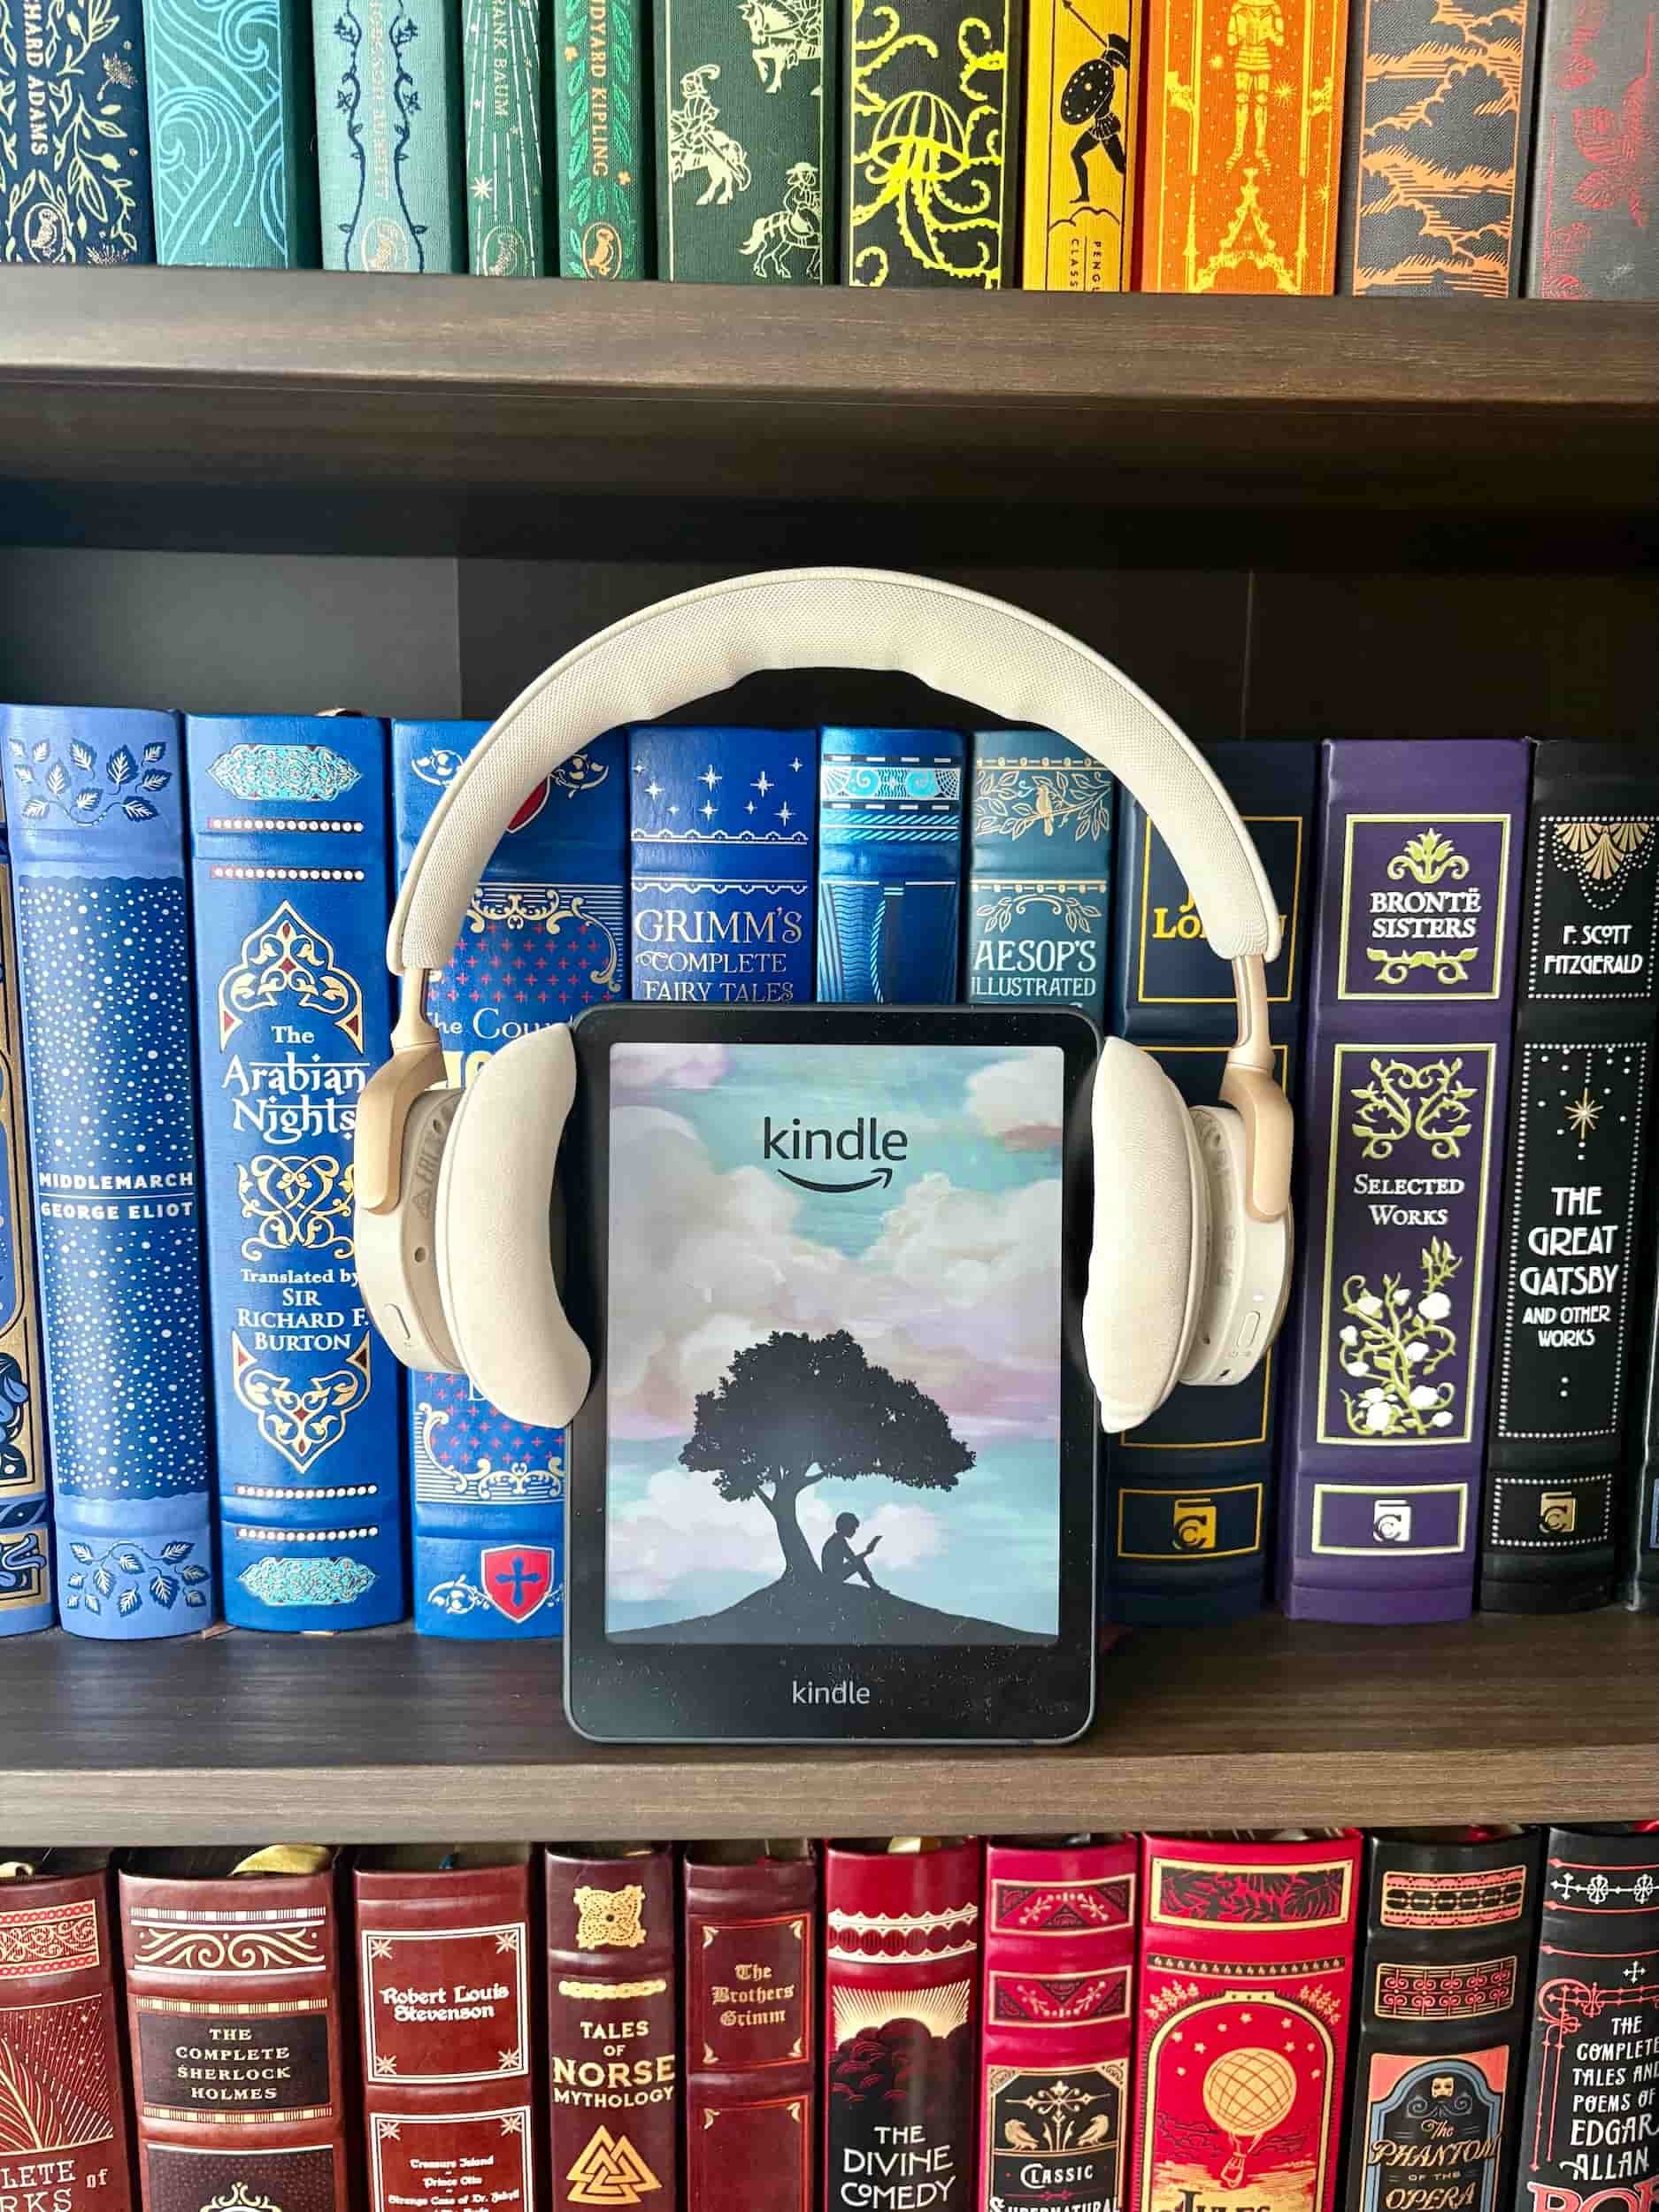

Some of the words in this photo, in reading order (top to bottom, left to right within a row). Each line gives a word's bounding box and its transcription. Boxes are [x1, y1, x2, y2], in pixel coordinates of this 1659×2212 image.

[588, 0, 608, 78] DYARD
[494, 58, 511, 116] BAUM
[27, 75, 49, 156] ADAMS
[591, 88, 610, 178] KIPLING
[1369, 887, 1482, 913] BRONTË
[634, 906, 803, 944] GRIMM'S
[1371, 917, 1478, 939] SISTERS
[1563, 925, 1578, 945] F.
[1580, 925, 1633, 945] SCOTT
[635, 949, 787, 973] COMPLETE
[973, 939, 1096, 972] AESOP'S
[1543, 953, 1644, 975] FITZGERALD
[643, 979, 712, 1002] FAIRY
[719, 980, 795, 1002] TALES
[971, 976, 1096, 996] ILLUSTRATED
[271, 1025, 316, 1045] The
[221, 1051, 368, 1096] Arabian
[232, 1094, 356, 1144] Nights
[764, 1116, 908, 1162] kindle
[38, 1171, 194, 1190] MIDDLEMARCH
[1353, 1173, 1465, 1195] SELECTED
[41, 1202, 120, 1220] GEORGE
[128, 1201, 194, 1219] ELIOT
[1550, 1186, 1603, 1217] THE
[1368, 1203, 1449, 1225] WORKS
[1527, 1224, 1619, 1256] GREAT
[240, 1268, 335, 1284] Translated
[340, 1268, 360, 1287] by
[1519, 1263, 1620, 1296] GATSBY
[282, 1287, 322, 1307] SIR
[235, 1307, 346, 1329] RICHARD
[351, 1307, 370, 1327] F.
[1522, 1306, 1557, 1325] AND
[1560, 1304, 1612, 1325] OTHER
[253, 1331, 352, 1352] BURTON
[1538, 1328, 1596, 1348] WORKS
[792, 1679, 871, 1705] kindle
[734, 1962, 772, 1982] The
[379, 1985, 447, 2005] Robert
[453, 1982, 511, 2004] Louis
[710, 1983, 795, 2006] Brothers
[394, 2004, 495, 2023] Stevenson
[719, 2009, 787, 2027] Grimm
[209, 2027, 253, 2041] THE
[580, 2020, 650, 2039] TALES
[1610, 2016, 1643, 2036] THE
[175, 2046, 290, 2061] COMPLETE
[603, 2044, 626, 2057] OF
[1576, 2036, 1659, 2062] COMPLETE
[177, 2064, 291, 2081] SHERLOCK
[551, 2054, 676, 2089] NORSE
[1571, 2067, 1628, 2086] TALES
[190, 2087, 278, 2101] HOLMES
[553, 2085, 675, 2108] MYTHOLOGY
[1571, 2093, 1632, 2114] POEMS
[1638, 2087, 1656, 2108] OF
[873, 2125, 926, 2146] THE
[1420, 2118, 1455, 2140] The
[1570, 2113, 1659, 2147] EDGAR
[842, 2144, 955, 2177] DIVINE
[1367, 2132, 1504, 2168] PHANTOM
[1559, 2146, 1650, 2181] ALLAN
[0, 2160, 76, 2190] LETE
[86, 2168, 109, 2188] of
[422, 2177, 458, 2189] Prince
[1019, 2162, 1094, 2190] CLASSIC
[1408, 2173, 1427, 2182] OF
[1434, 2170, 1461, 2181] THE
[840, 2175, 956, 2210] COMEDY
[1385, 2181, 1477, 2210] OPERA
